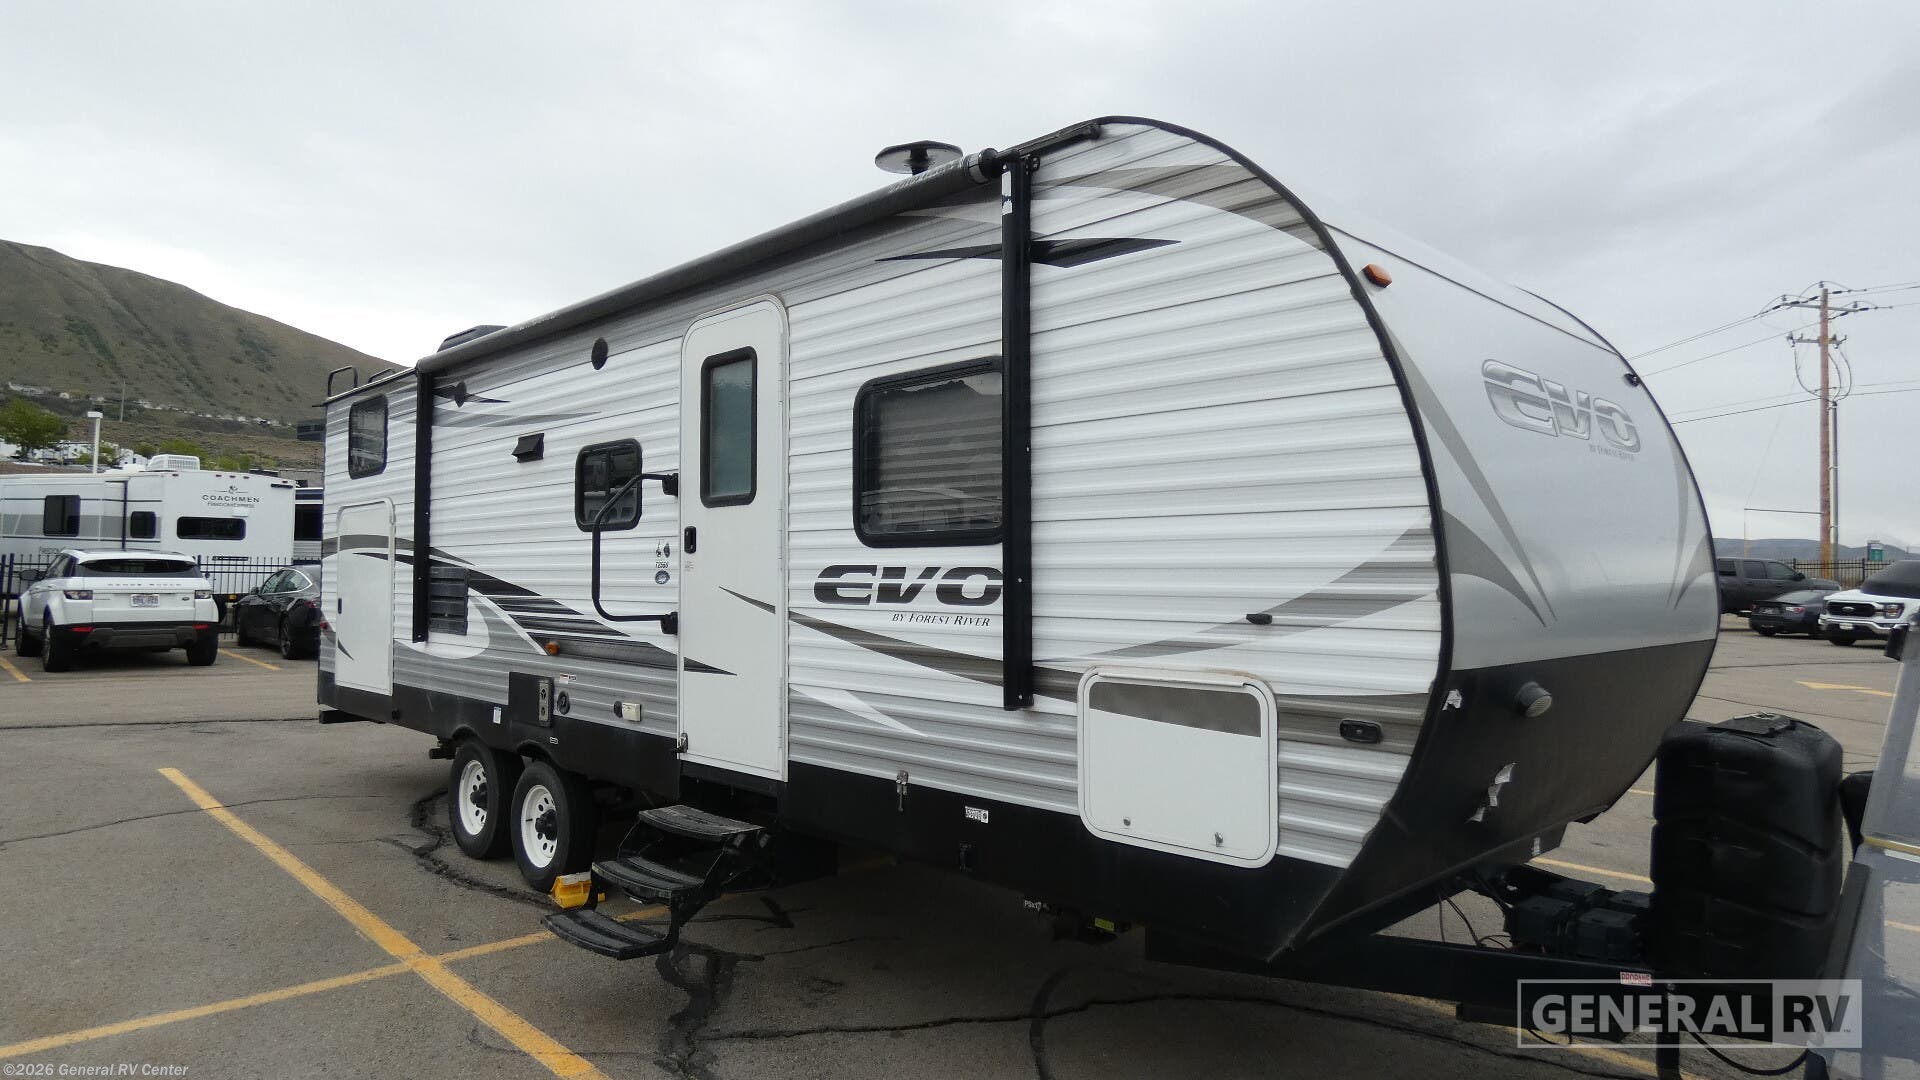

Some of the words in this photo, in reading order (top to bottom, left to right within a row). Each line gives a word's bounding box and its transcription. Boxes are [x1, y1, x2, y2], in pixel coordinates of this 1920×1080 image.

[1482, 359, 1640, 453] EVO
[202, 494, 260, 502] COACHMEN
[813, 564, 1003, 606] EVO
[908, 613, 952, 624] FOREST
[954, 615, 991, 626] RIVER
